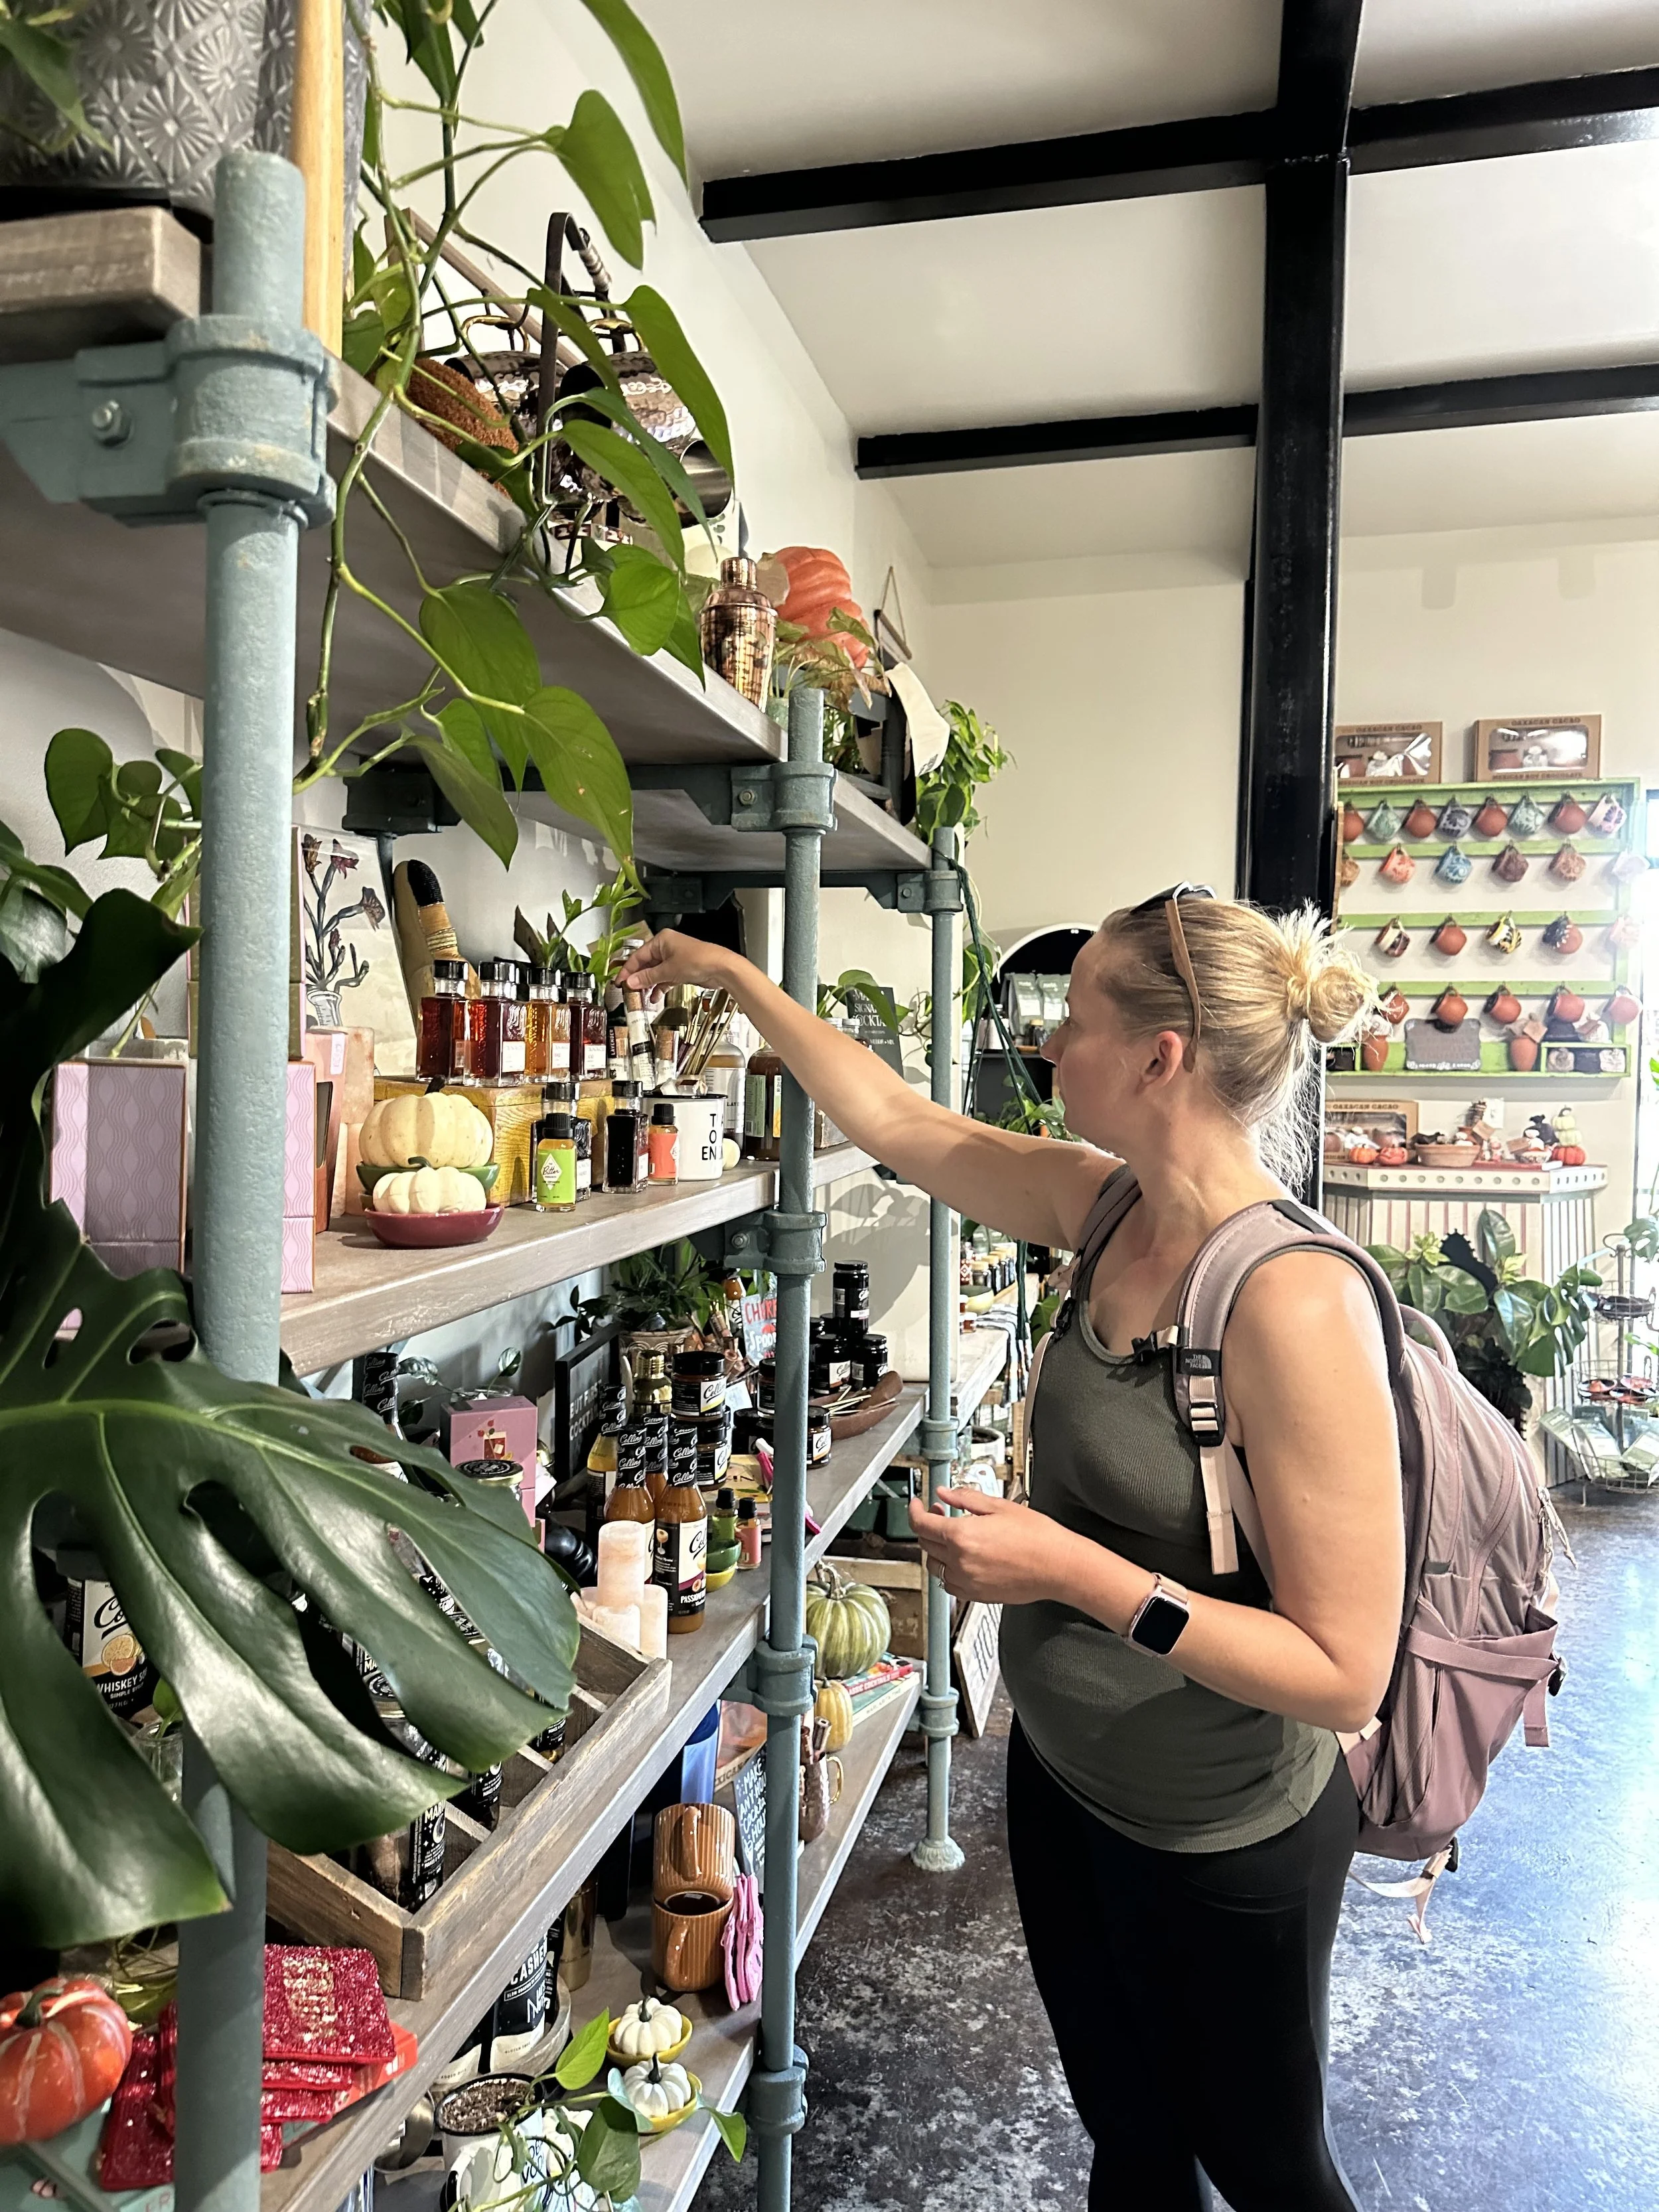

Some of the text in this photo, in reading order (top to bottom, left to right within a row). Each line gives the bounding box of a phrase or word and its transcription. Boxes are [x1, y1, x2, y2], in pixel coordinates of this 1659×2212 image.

[543, 1165, 559, 1175] Bitter
[620, 1434, 642, 1446] Collins
[673, 1447, 696, 1461] Collins
[618, 1458, 641, 1471] Collins
[673, 1473, 695, 1486] Collins
[110, 1689, 131, 1699] SIMPLE
[743, 1757, 762, 1793] MAKE
